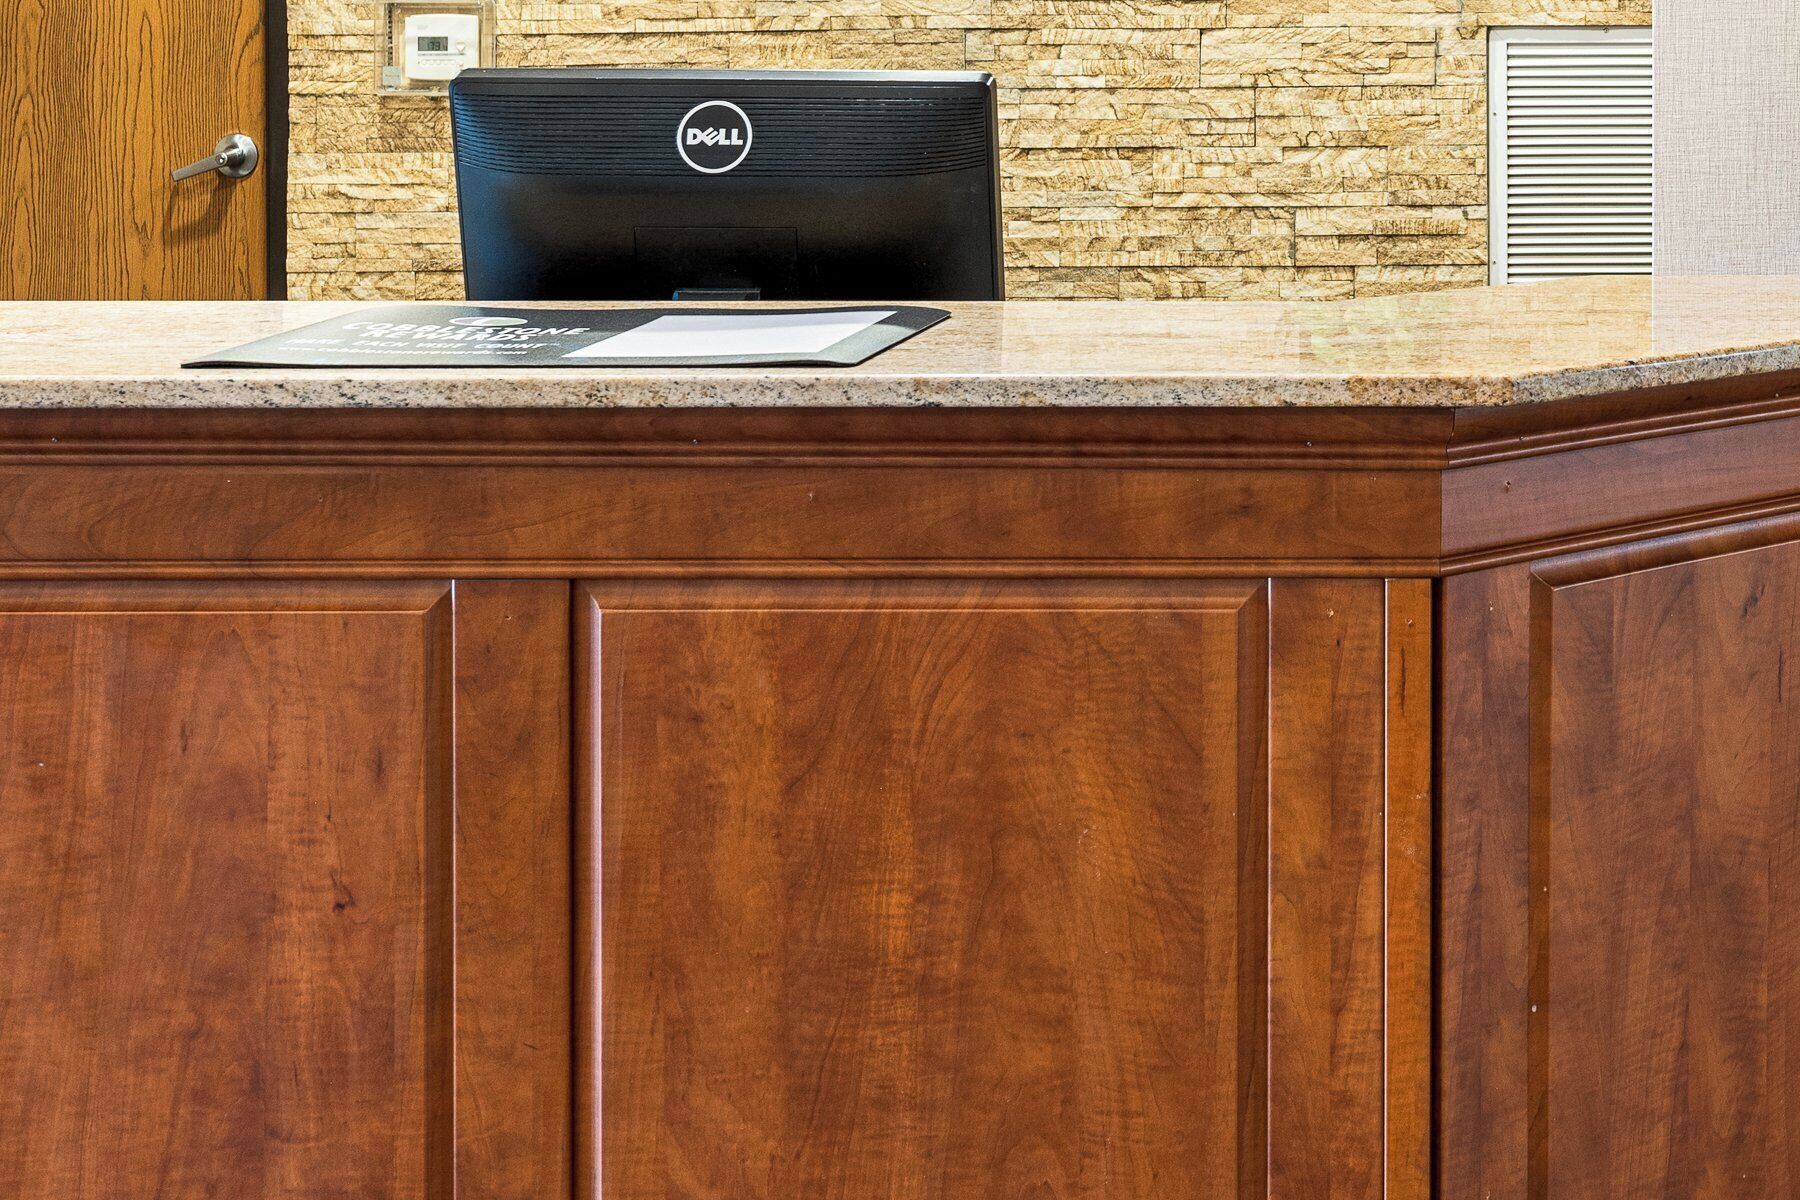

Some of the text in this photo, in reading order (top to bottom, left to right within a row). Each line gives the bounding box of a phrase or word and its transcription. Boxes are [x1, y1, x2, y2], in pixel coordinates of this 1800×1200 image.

[686, 127, 743, 146] DELL
[343, 322, 590, 335] COBBLESTONE
[359, 330, 535, 341] REWARDS
